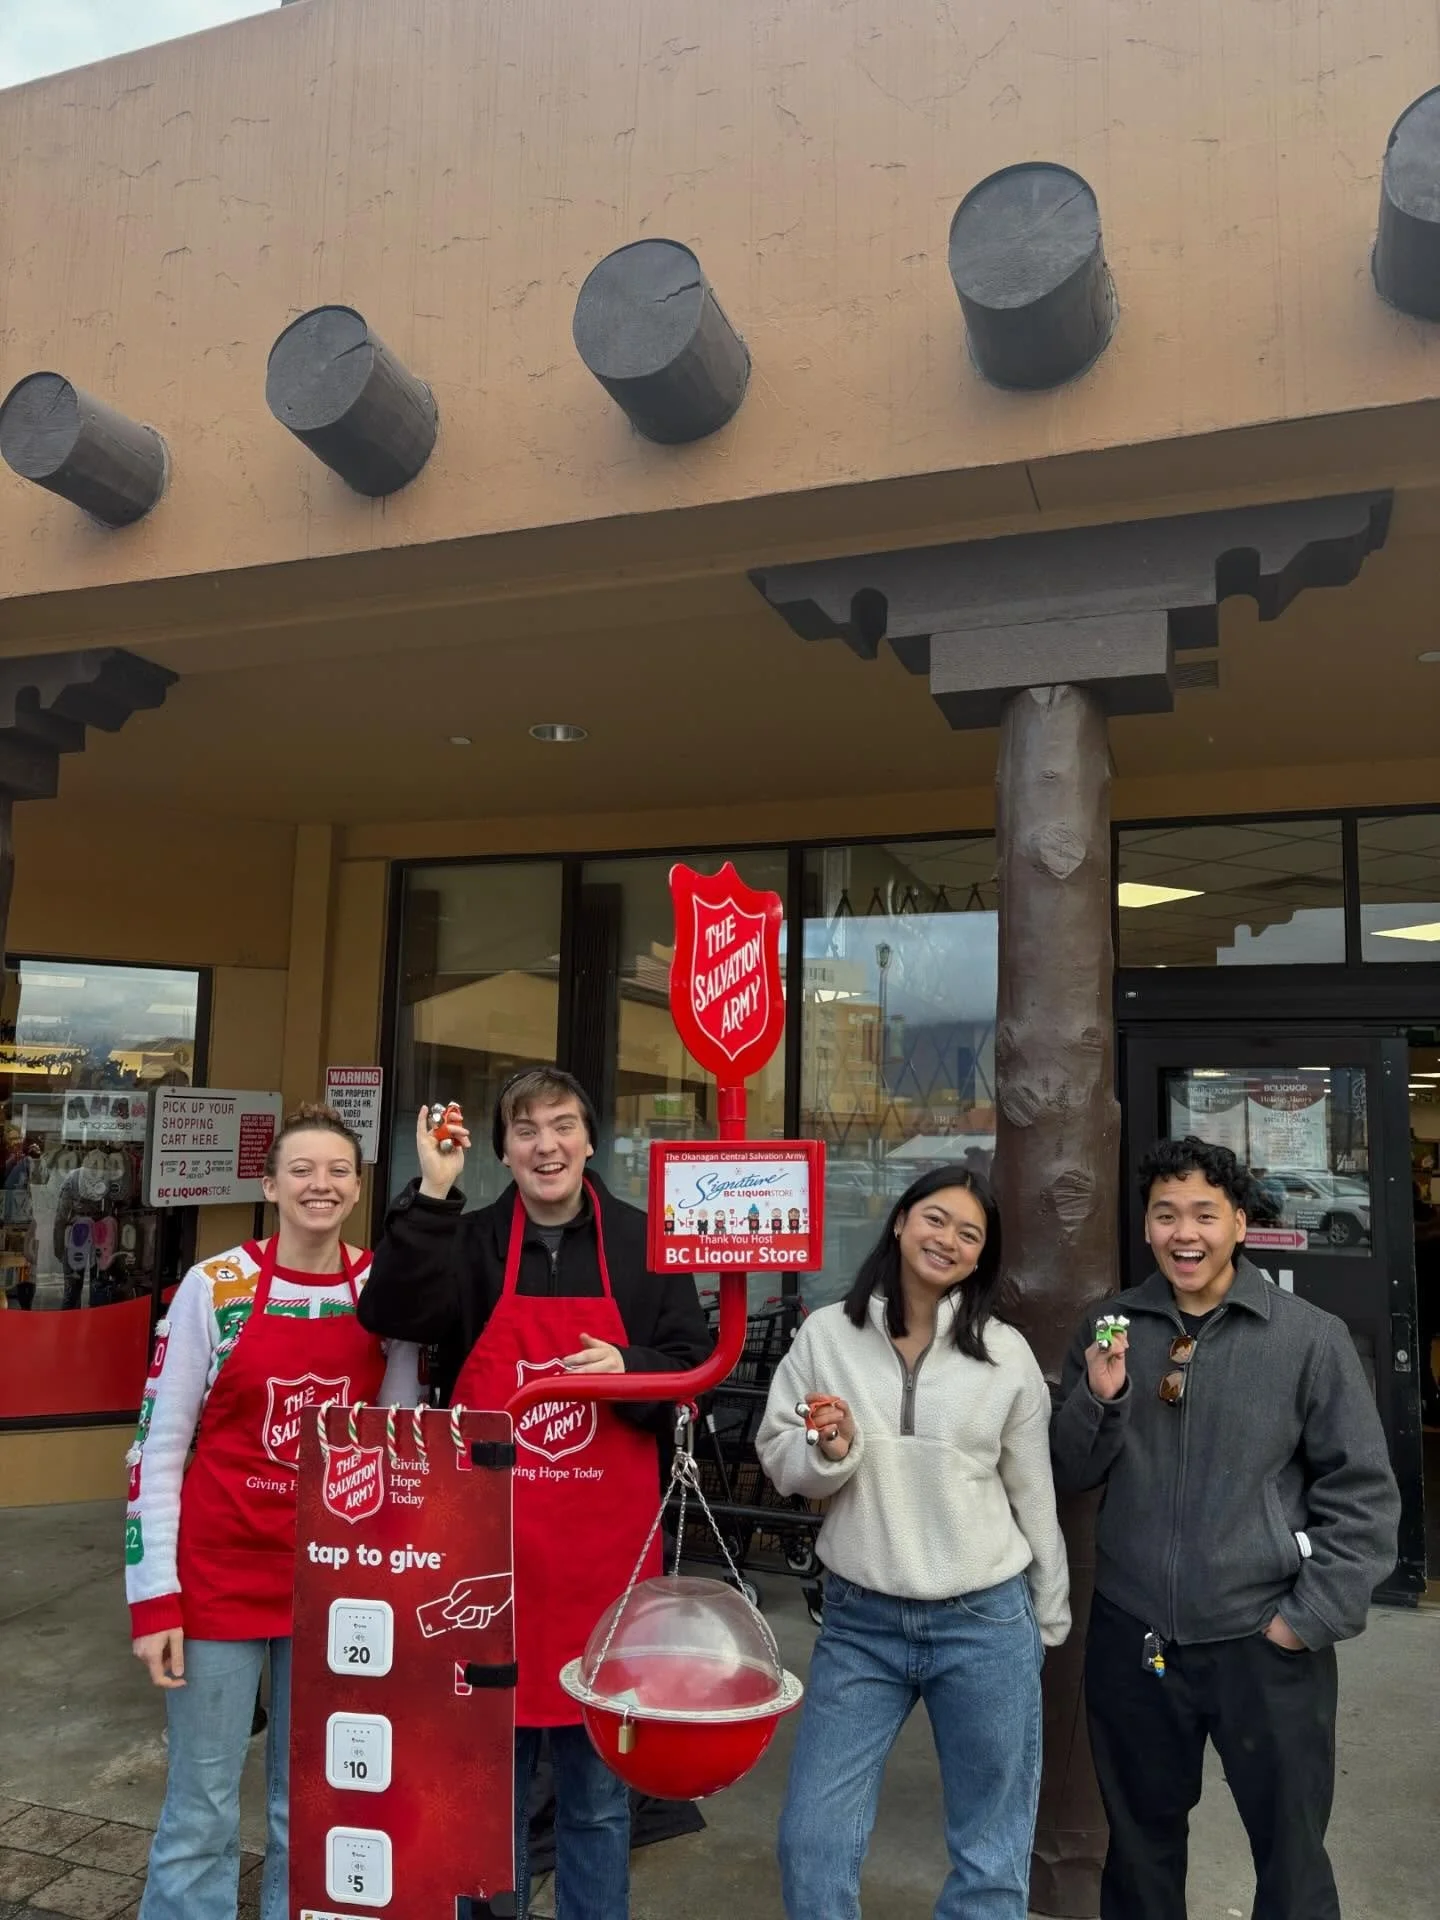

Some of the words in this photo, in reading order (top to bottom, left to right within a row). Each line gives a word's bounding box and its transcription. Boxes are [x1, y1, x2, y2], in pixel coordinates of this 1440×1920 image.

[705, 913, 736, 958] THE
[695, 930, 761, 1012] SALVATION
[720, 975, 761, 1039] ARMY
[329, 1071, 379, 1084] WARNING
[330, 1089, 343, 1097] THIS
[345, 1089, 377, 1098] PROPERTY
[162, 1101, 187, 1113] PICK
[191, 1102, 205, 1114] UP
[209, 1103, 235, 1114] YOUR
[332, 1099, 352, 1107] UNDER
[343, 1109, 361, 1117] VIDEO
[161, 1117, 215, 1130] SHOPPING
[161, 1134, 188, 1145] CART
[192, 1134, 219, 1145] HERE
[666, 1153, 676, 1161] The
[681, 1153, 719, 1162] Okanagan
[720, 1153, 748, 1161] Central
[749, 1152, 784, 1161] Salvation
[785, 1152, 806, 1162] Army
[160, 1160, 164, 1177] 1
[179, 1160, 187, 1176] 2
[204, 1160, 211, 1176] 3
[157, 1188, 172, 1198] BC
[678, 1172, 790, 1209] Signature
[723, 1190, 735, 1198] BC
[699, 1234, 729, 1244] Thank
[731, 1235, 749, 1244] You
[751, 1235, 774, 1244] Host
[665, 1248, 690, 1264] BC
[758, 1246, 808, 1263] Store
[284, 1386, 316, 1416] THE
[543, 1405, 586, 1445] ARMY
[336, 1454, 360, 1476] THE
[390, 1458, 430, 1475] Giving
[328, 1459, 377, 1500] SALVATION
[512, 1467, 536, 1480] ving
[540, 1466, 570, 1482] Hope
[573, 1467, 604, 1480] Today
[246, 1476, 287, 1493] Giving
[390, 1475, 421, 1491] Hope
[345, 1479, 376, 1511] ARMY
[389, 1491, 425, 1509] Today
[126, 1526, 139, 1548] 2
[307, 1541, 349, 1570] tap
[356, 1544, 383, 1566] to
[343, 1645, 371, 1664] $20
[343, 1760, 368, 1779] $10
[347, 1874, 364, 1893] $5
